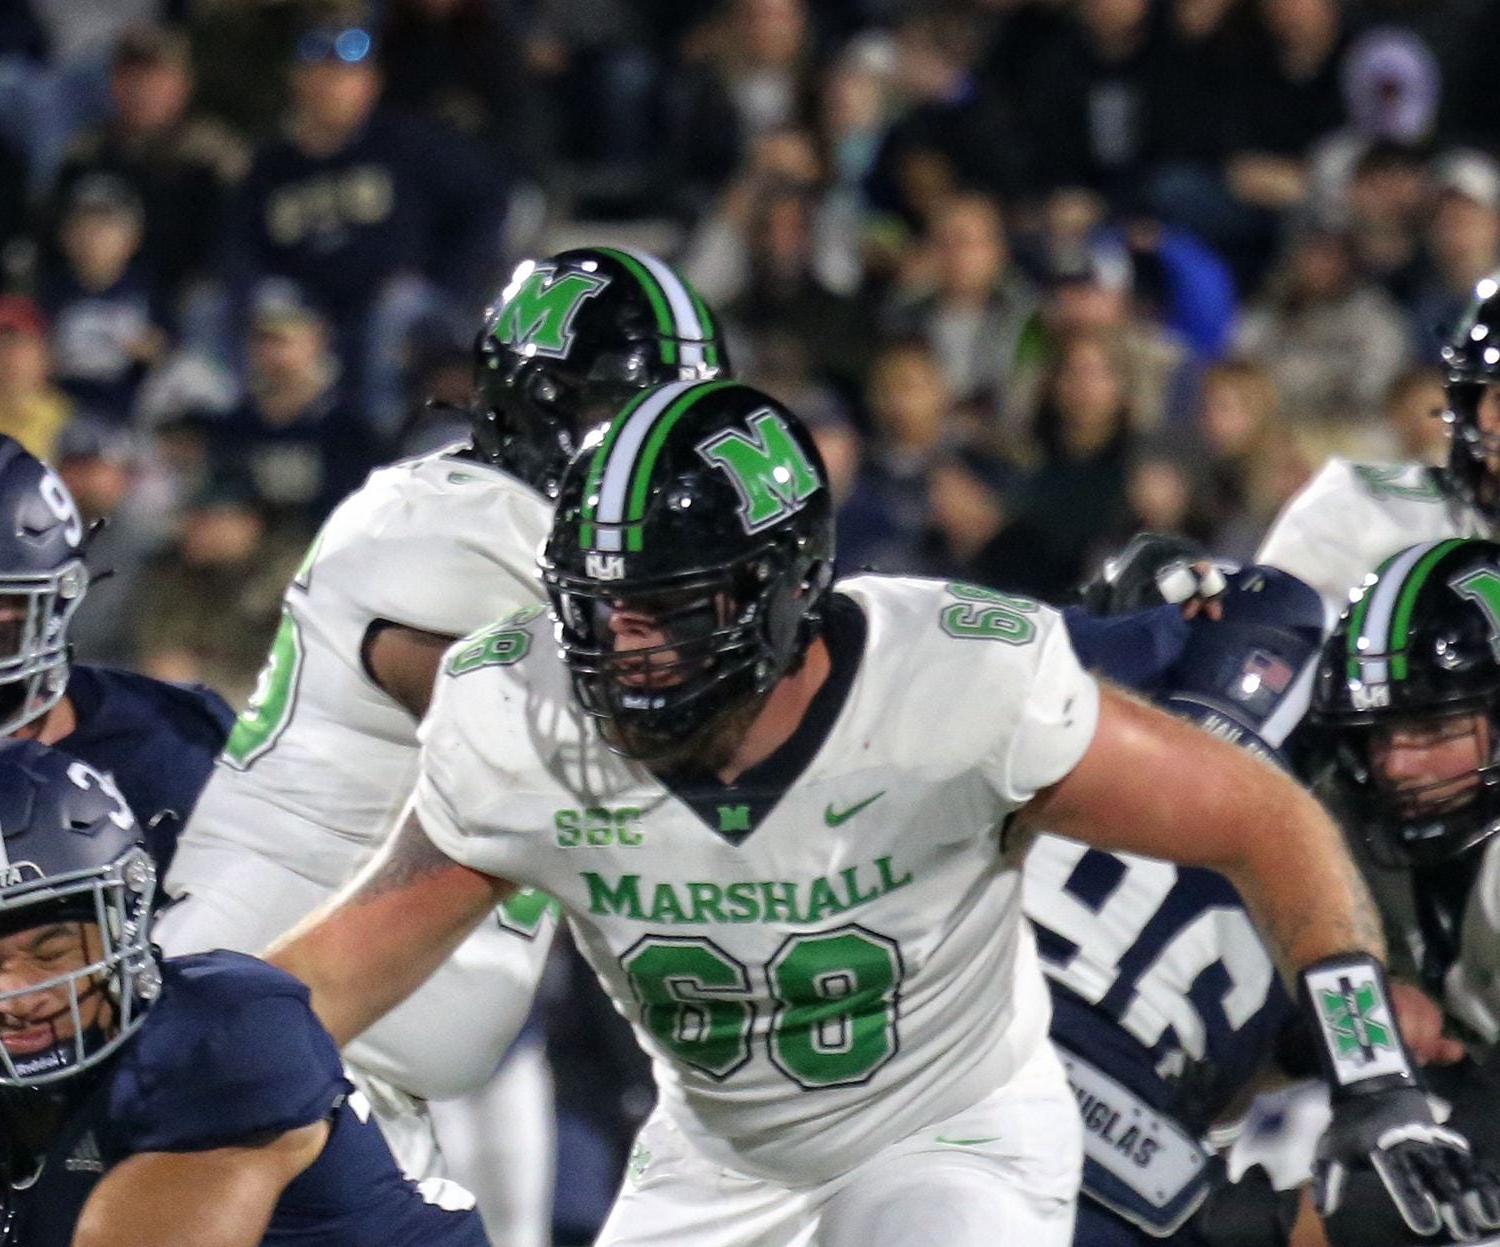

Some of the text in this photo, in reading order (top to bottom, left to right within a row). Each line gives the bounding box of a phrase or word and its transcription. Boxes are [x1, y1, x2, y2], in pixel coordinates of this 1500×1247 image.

[490, 264, 613, 360] M
[39, 464, 82, 547] 9
[694, 405, 823, 535] M
[65, 760, 136, 831] 3
[553, 805, 645, 849] SBC
[579, 855, 914, 925] MARSHALL
[618, 921, 906, 1092] 68
